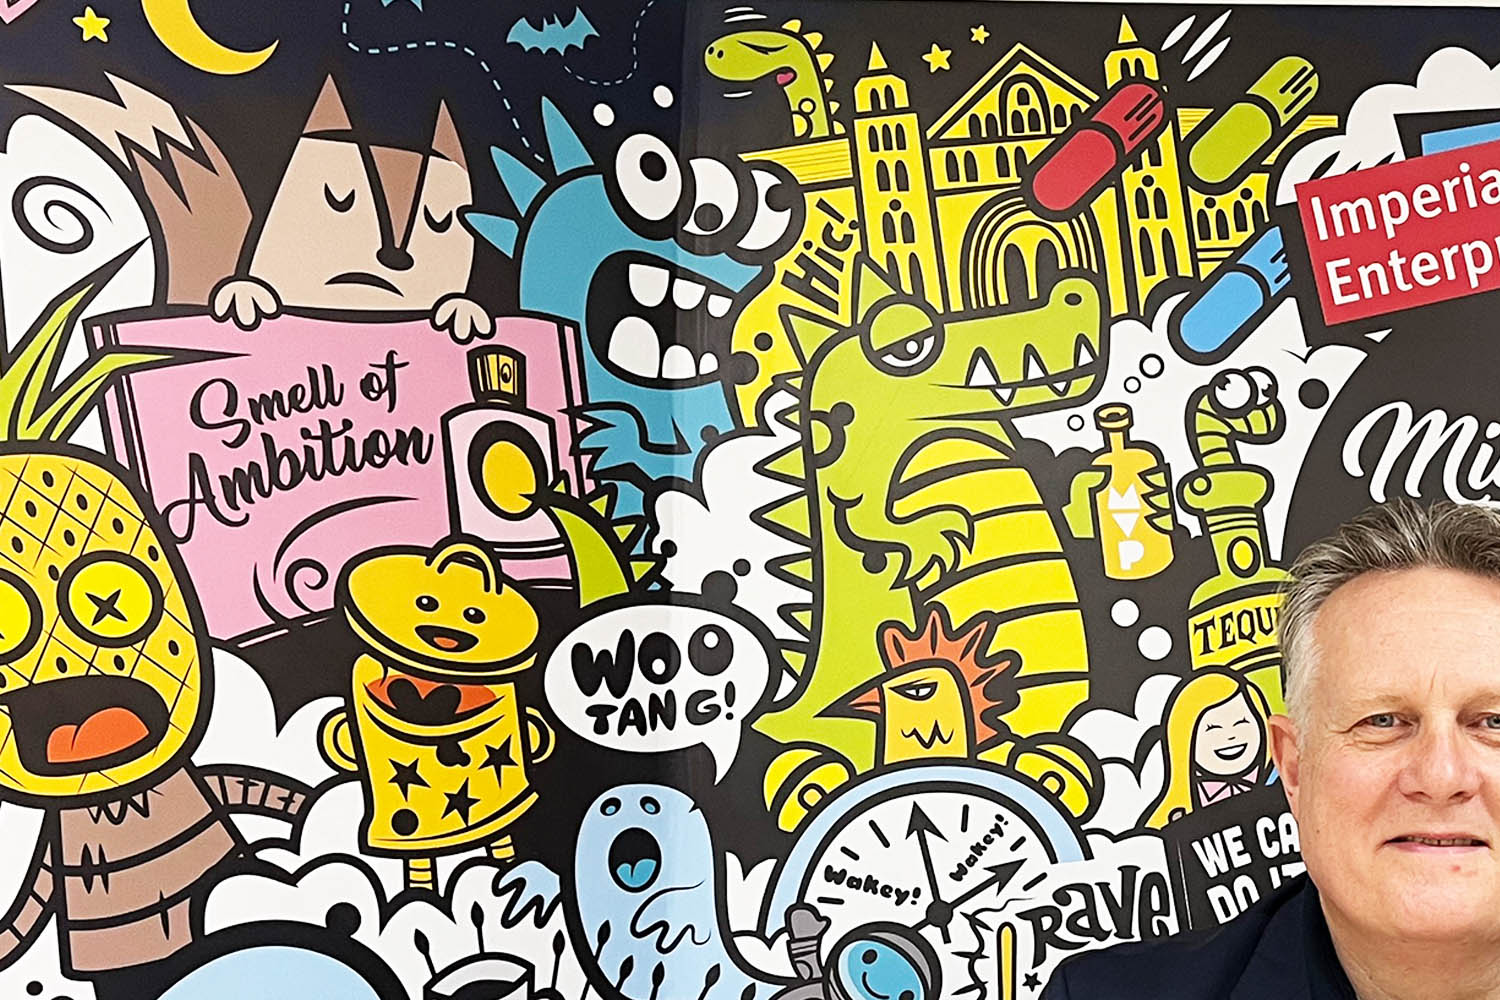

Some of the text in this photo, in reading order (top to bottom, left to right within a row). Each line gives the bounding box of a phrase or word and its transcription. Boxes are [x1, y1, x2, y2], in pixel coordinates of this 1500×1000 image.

[780, 197, 860, 315] Hic!
[189, 350, 410, 449] Smell of
[160, 418, 434, 544] Ambition
[1108, 483, 1144, 571] MVP
[570, 629, 734, 699] WOO
[1193, 606, 1278, 656] TEQU
[585, 681, 736, 736] TANG!
[949, 814, 1009, 882] Wakey!
[1191, 812, 1301, 878] WE CA
[824, 865, 922, 906] Wakey!
